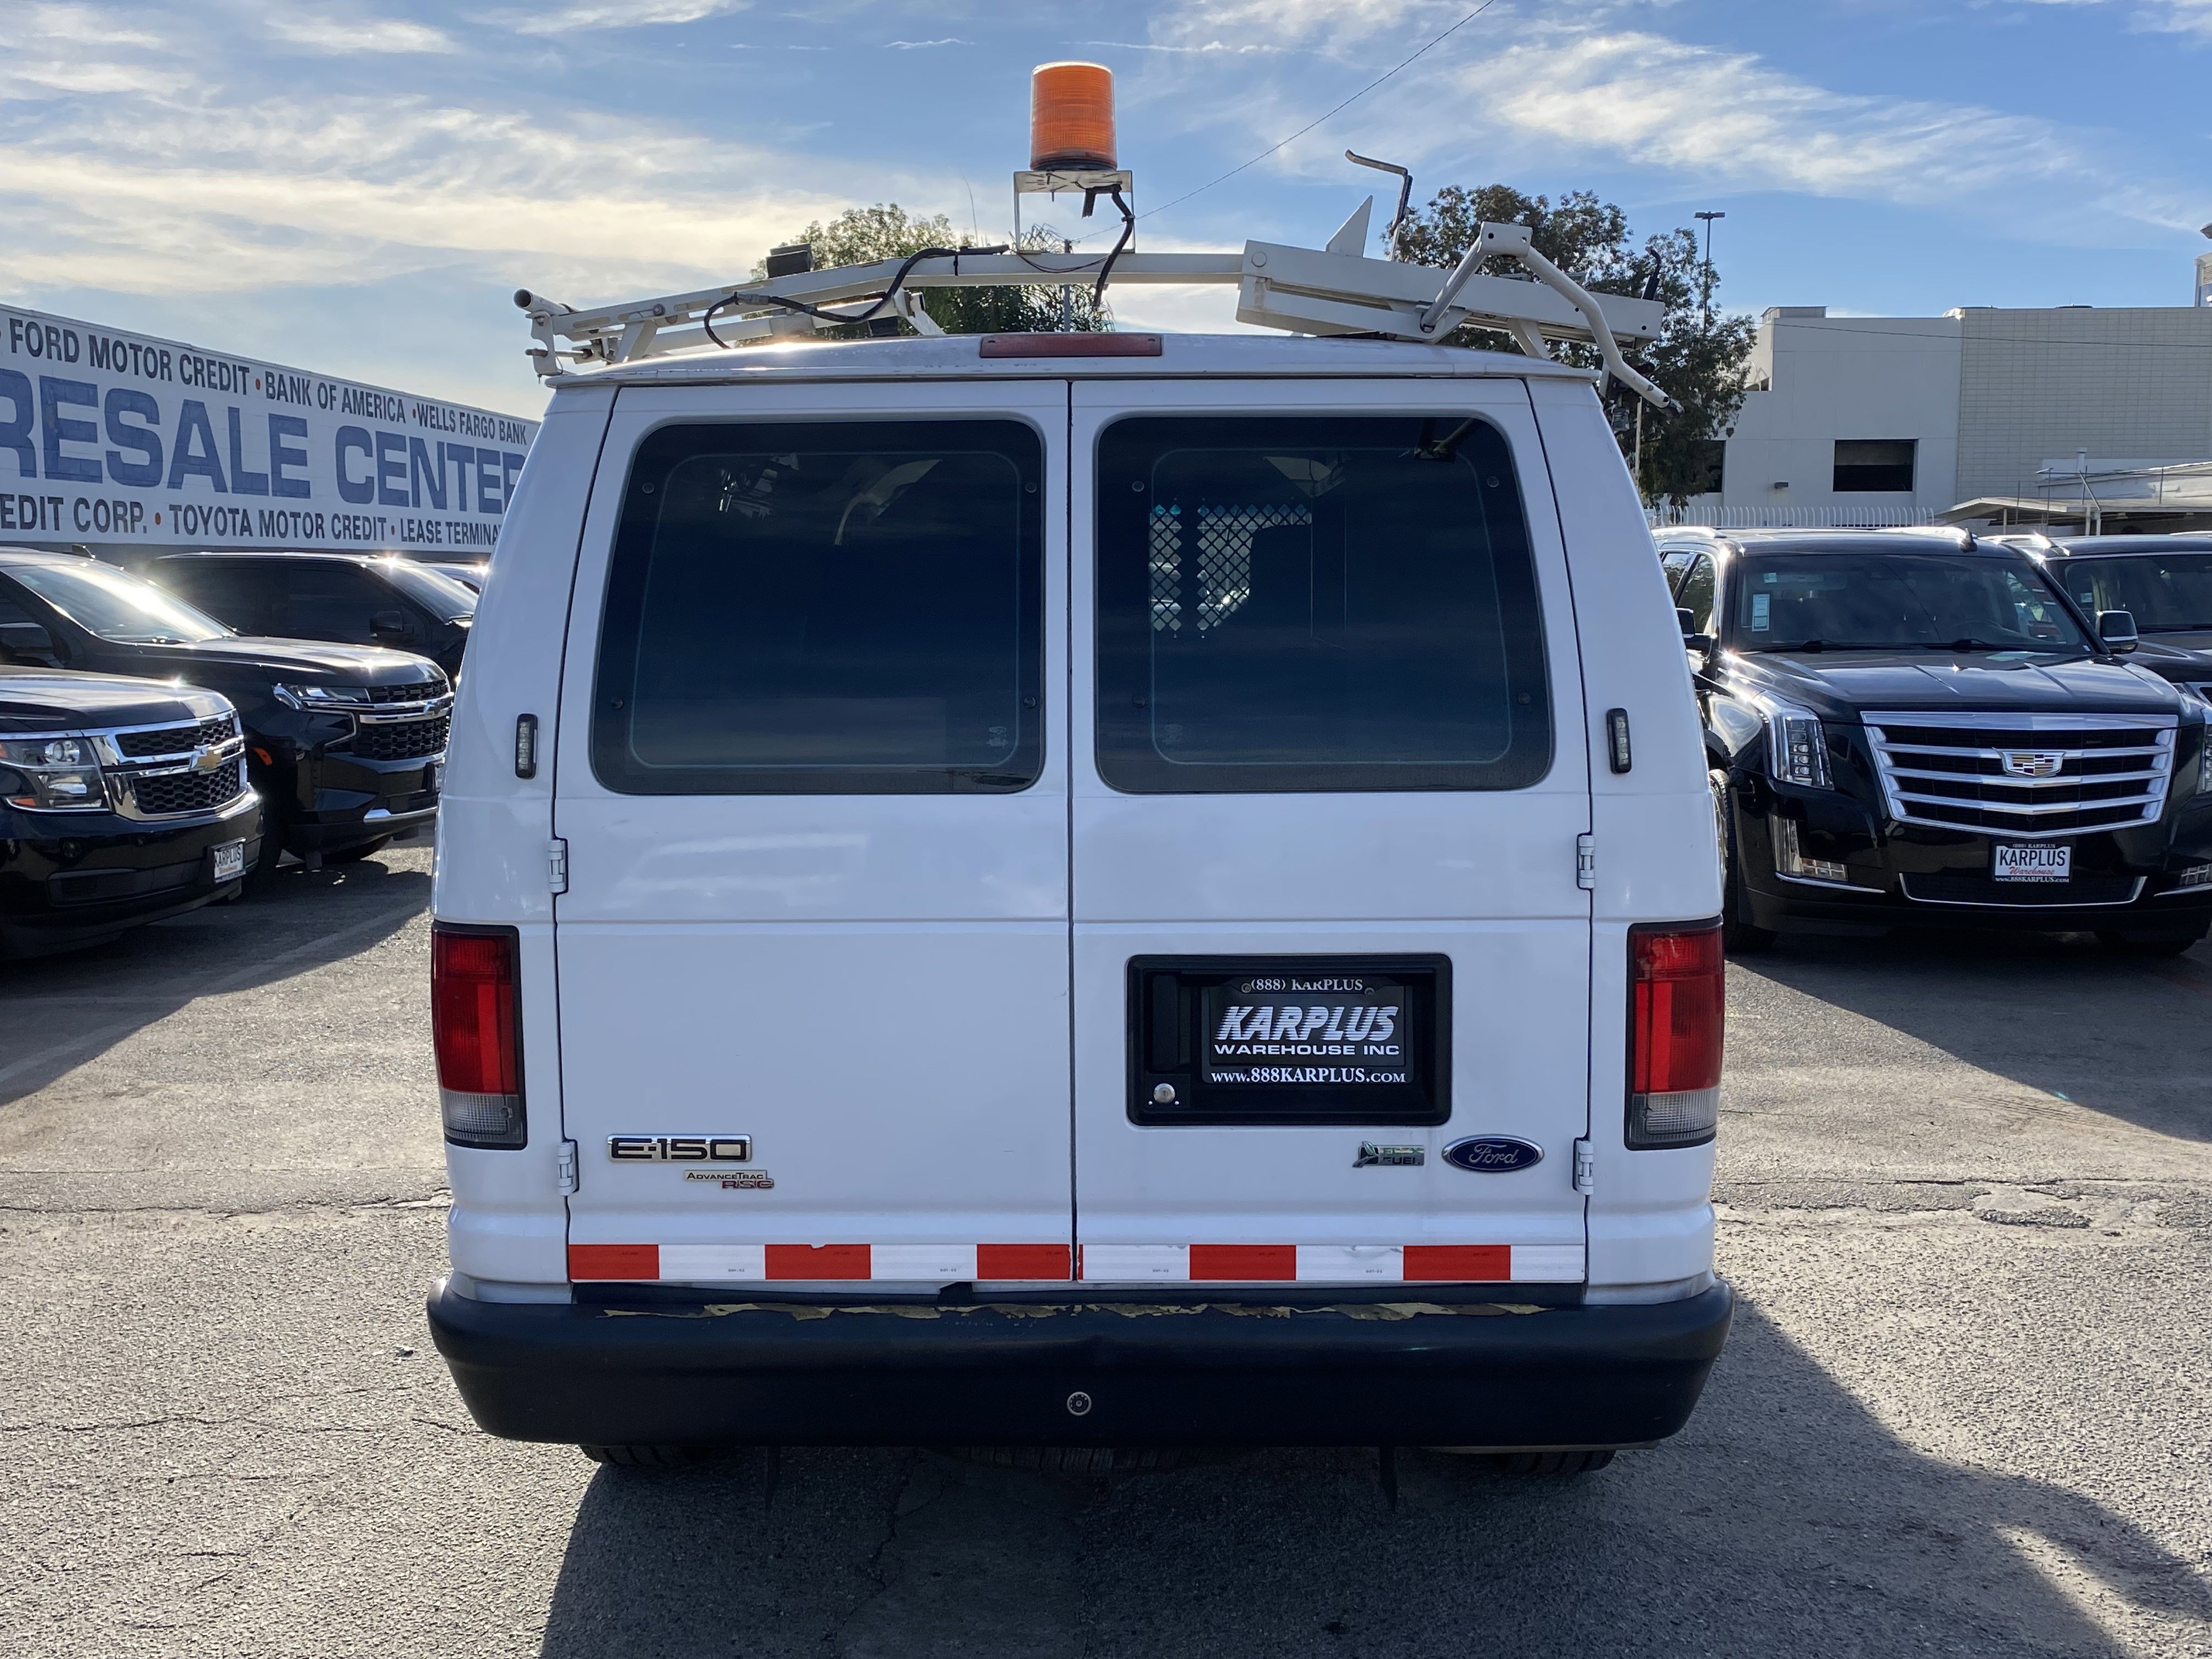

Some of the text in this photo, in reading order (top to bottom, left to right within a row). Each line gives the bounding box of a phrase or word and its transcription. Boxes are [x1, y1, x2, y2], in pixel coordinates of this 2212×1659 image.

[9, 318, 527, 445] FORD MOTOR CREDIT BANK OF AMERICA WELLS FARGO BANK
[0, 368, 311, 500] RESALE
[0, 494, 501, 545] EDIT CORP. TOYOTA MOTOR CREDIT LEASE TERMINA
[2000, 850, 2066, 866] KARPLUS
[2009, 866, 2055, 875] Warehouse
[1251, 978, 1286, 991] (888)
[1214, 1005, 1400, 1041] KARPLUS
[1214, 1045, 1400, 1056] WAREHOUSE INC
[611, 1137, 747, 1160] E-150
[1468, 1143, 1518, 1165] Ford
[721, 1180, 774, 1189] RSC
